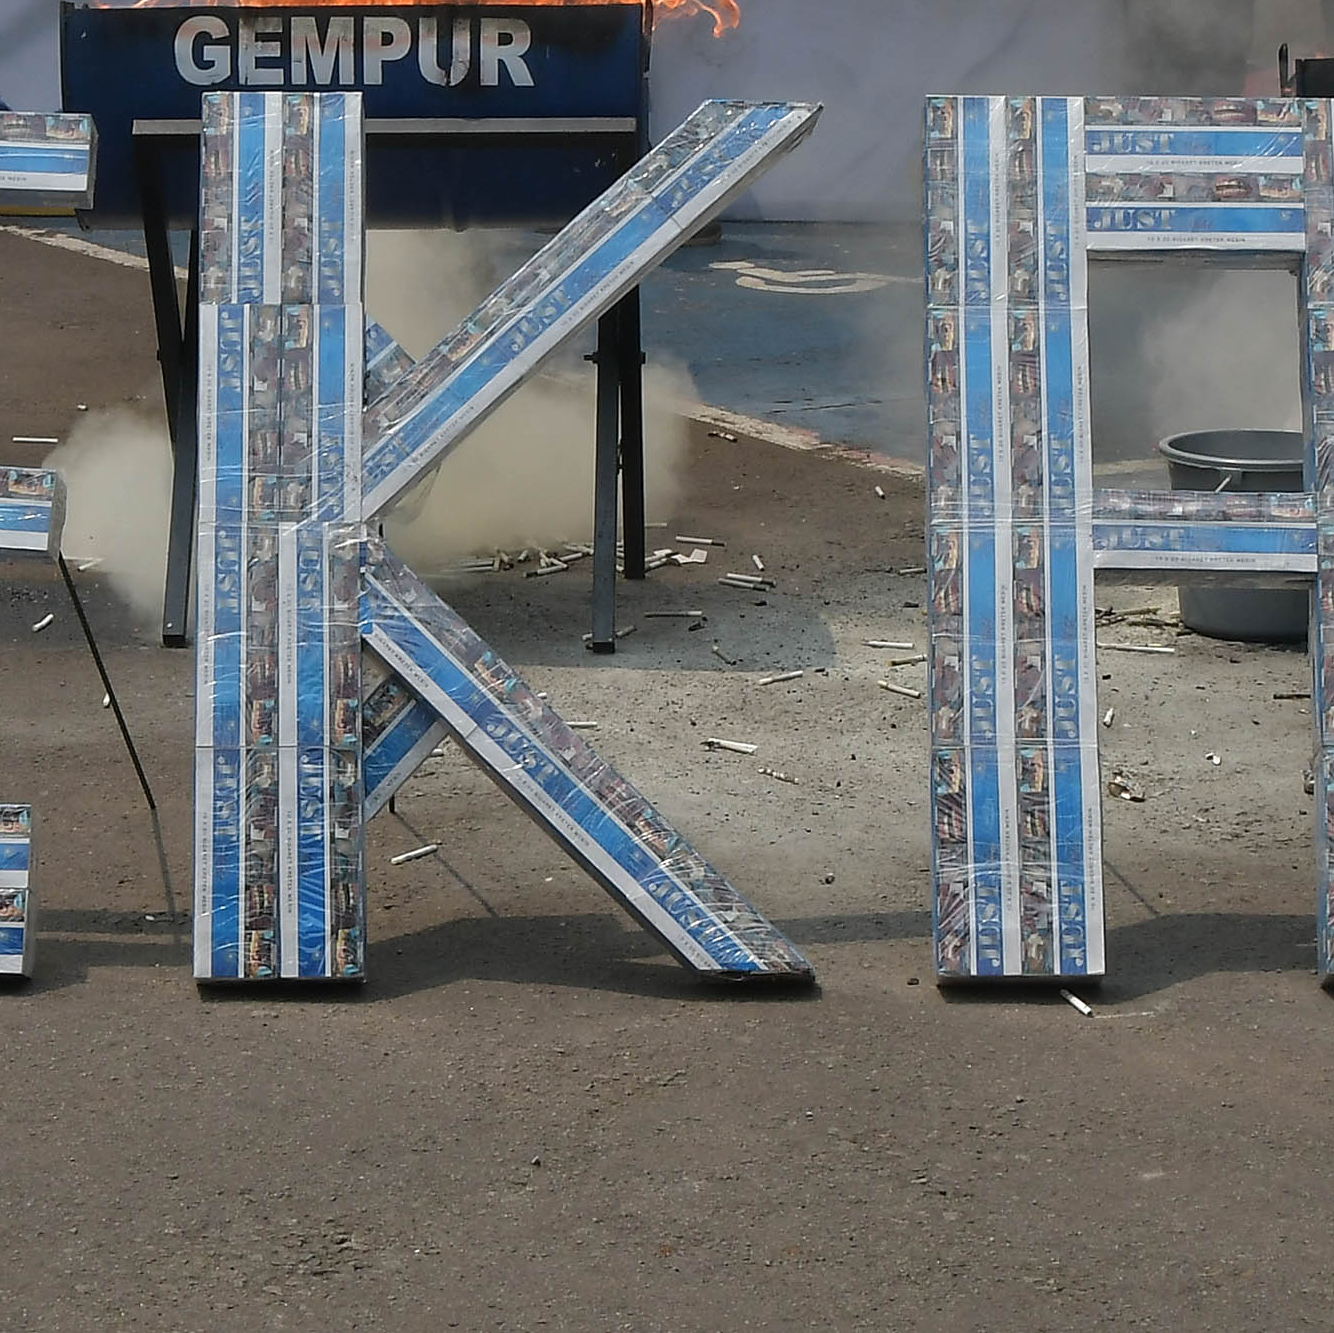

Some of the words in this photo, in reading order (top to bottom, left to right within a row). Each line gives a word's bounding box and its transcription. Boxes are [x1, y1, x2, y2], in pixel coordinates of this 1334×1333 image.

[173, 15, 534, 87] GEMPUR
[1091, 132, 1176, 154] JUST
[1093, 208, 1177, 230] JUST
[970, 653, 996, 739] JUST
[1053, 653, 1078, 739] JUST
[484, 717, 564, 783] JUST
[975, 880, 1002, 968] JUST
[1059, 880, 1086, 968] JUST
